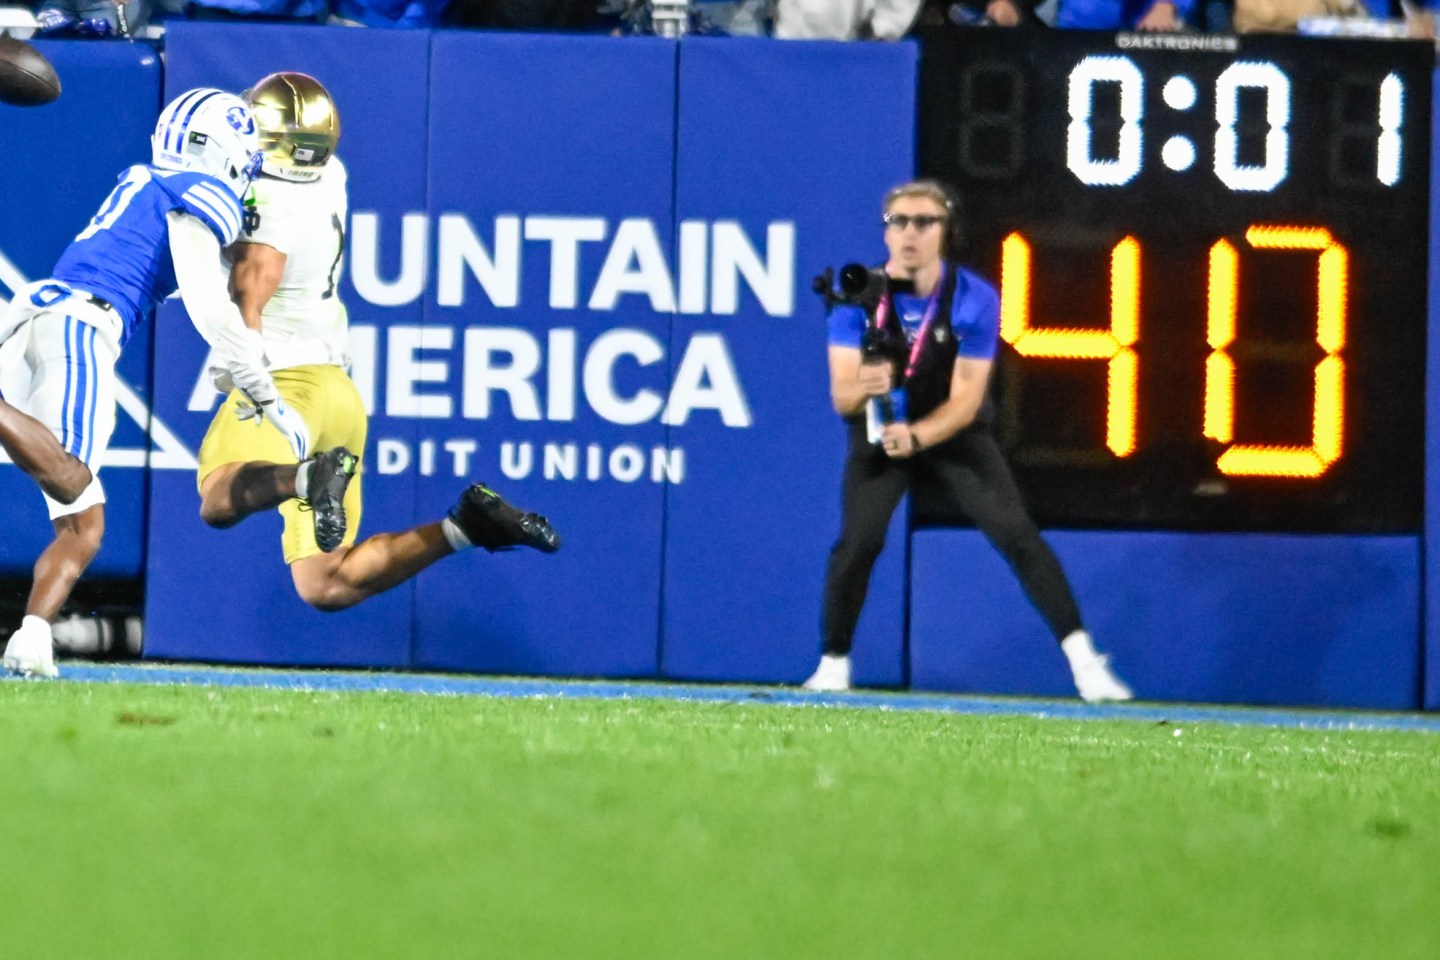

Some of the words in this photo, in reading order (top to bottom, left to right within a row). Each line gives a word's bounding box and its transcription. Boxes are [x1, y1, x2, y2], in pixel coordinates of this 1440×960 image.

[1115, 33, 1239, 52] DAKTRONICS
[350, 211, 796, 318] UNTAIN
[348, 323, 753, 428] ERICA
[1000, 225, 1349, 479] 40
[363, 438, 477, 477] DIT
[499, 441, 685, 484] UNION
